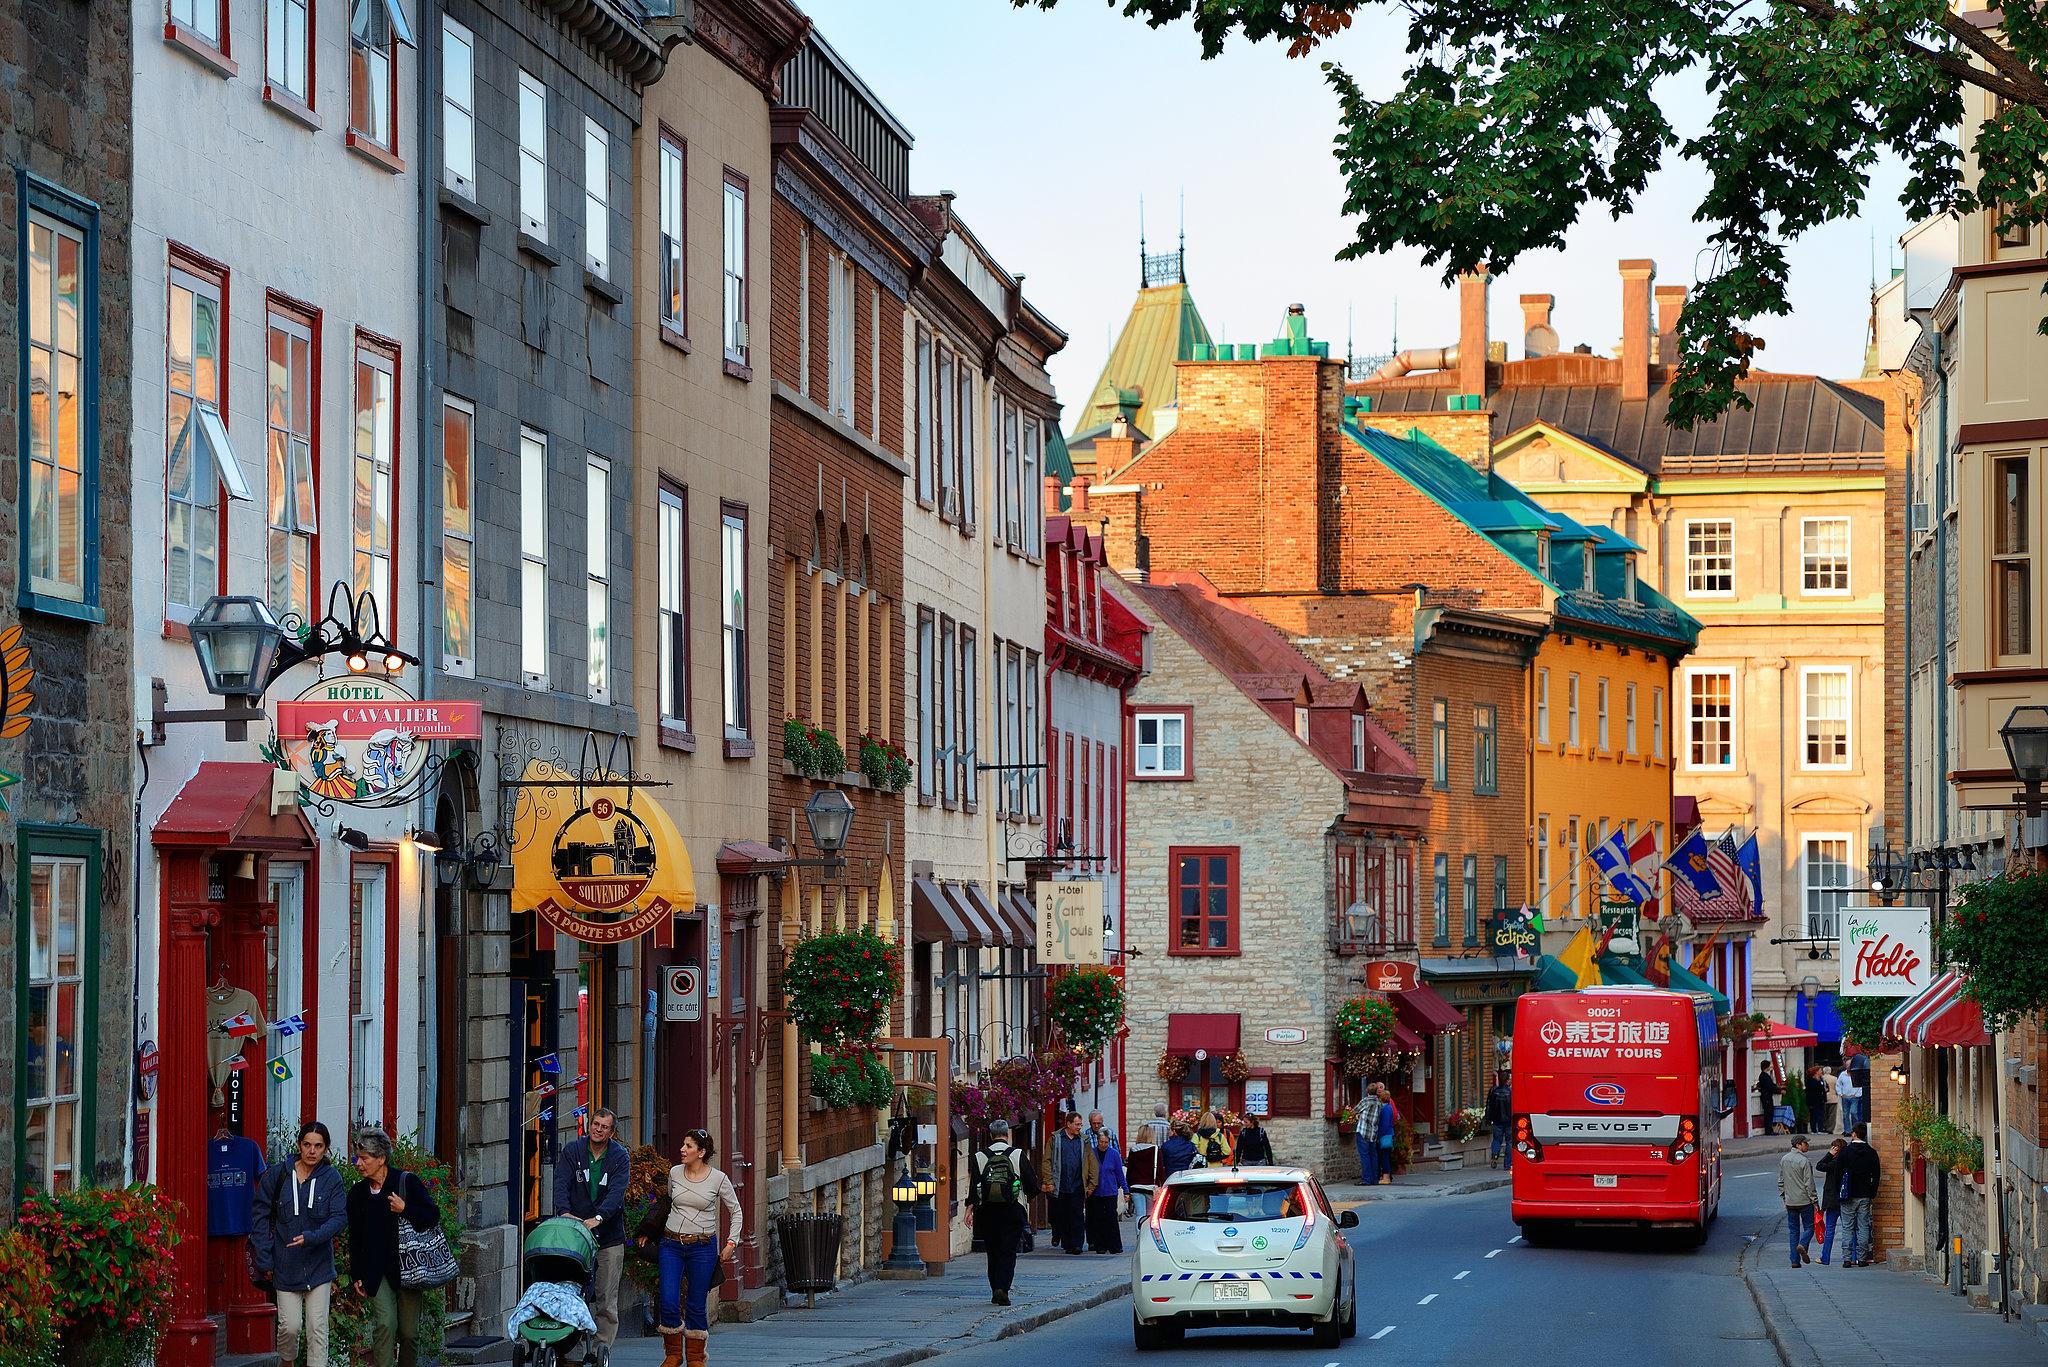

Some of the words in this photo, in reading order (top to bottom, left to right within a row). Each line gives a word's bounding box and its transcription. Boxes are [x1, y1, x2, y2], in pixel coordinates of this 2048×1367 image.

[327, 684, 384, 700] HÔTEL
[342, 708, 438, 723] CAVALIER
[394, 723, 409, 733] du
[413, 723, 451, 733] moulin
[597, 802, 608, 814] 56
[578, 884, 630, 904] SOUVENIRS
[1058, 886, 1084, 895] Hôtel
[543, 903, 559, 923] LA
[560, 918, 604, 939] PORTE
[1045, 893, 1053, 957] AUBERGE
[1055, 897, 1085, 943] Saint
[1064, 919, 1093, 960] Louis
[1495, 926, 1536, 947] Eclipse
[1850, 919, 1879, 945] petite
[1088, 950, 1098, 960] 48
[1851, 933, 1921, 987] Italie
[668, 1003, 675, 1012] DE
[676, 1003, 684, 1012] CE
[685, 1003, 698, 1012] CÔTÉ
[1587, 1008, 1621, 1018] 90021
[1565, 1021, 1670, 1044] 泰安旅遊
[1768, 1038, 1799, 1049] RESTAURANT
[1547, 1047, 1610, 1058] SAFEWAY
[1615, 1048, 1662, 1059] TOURS
[231, 1069, 240, 1122] HOTEL
[1558, 1123, 1652, 1132] PREVOST
